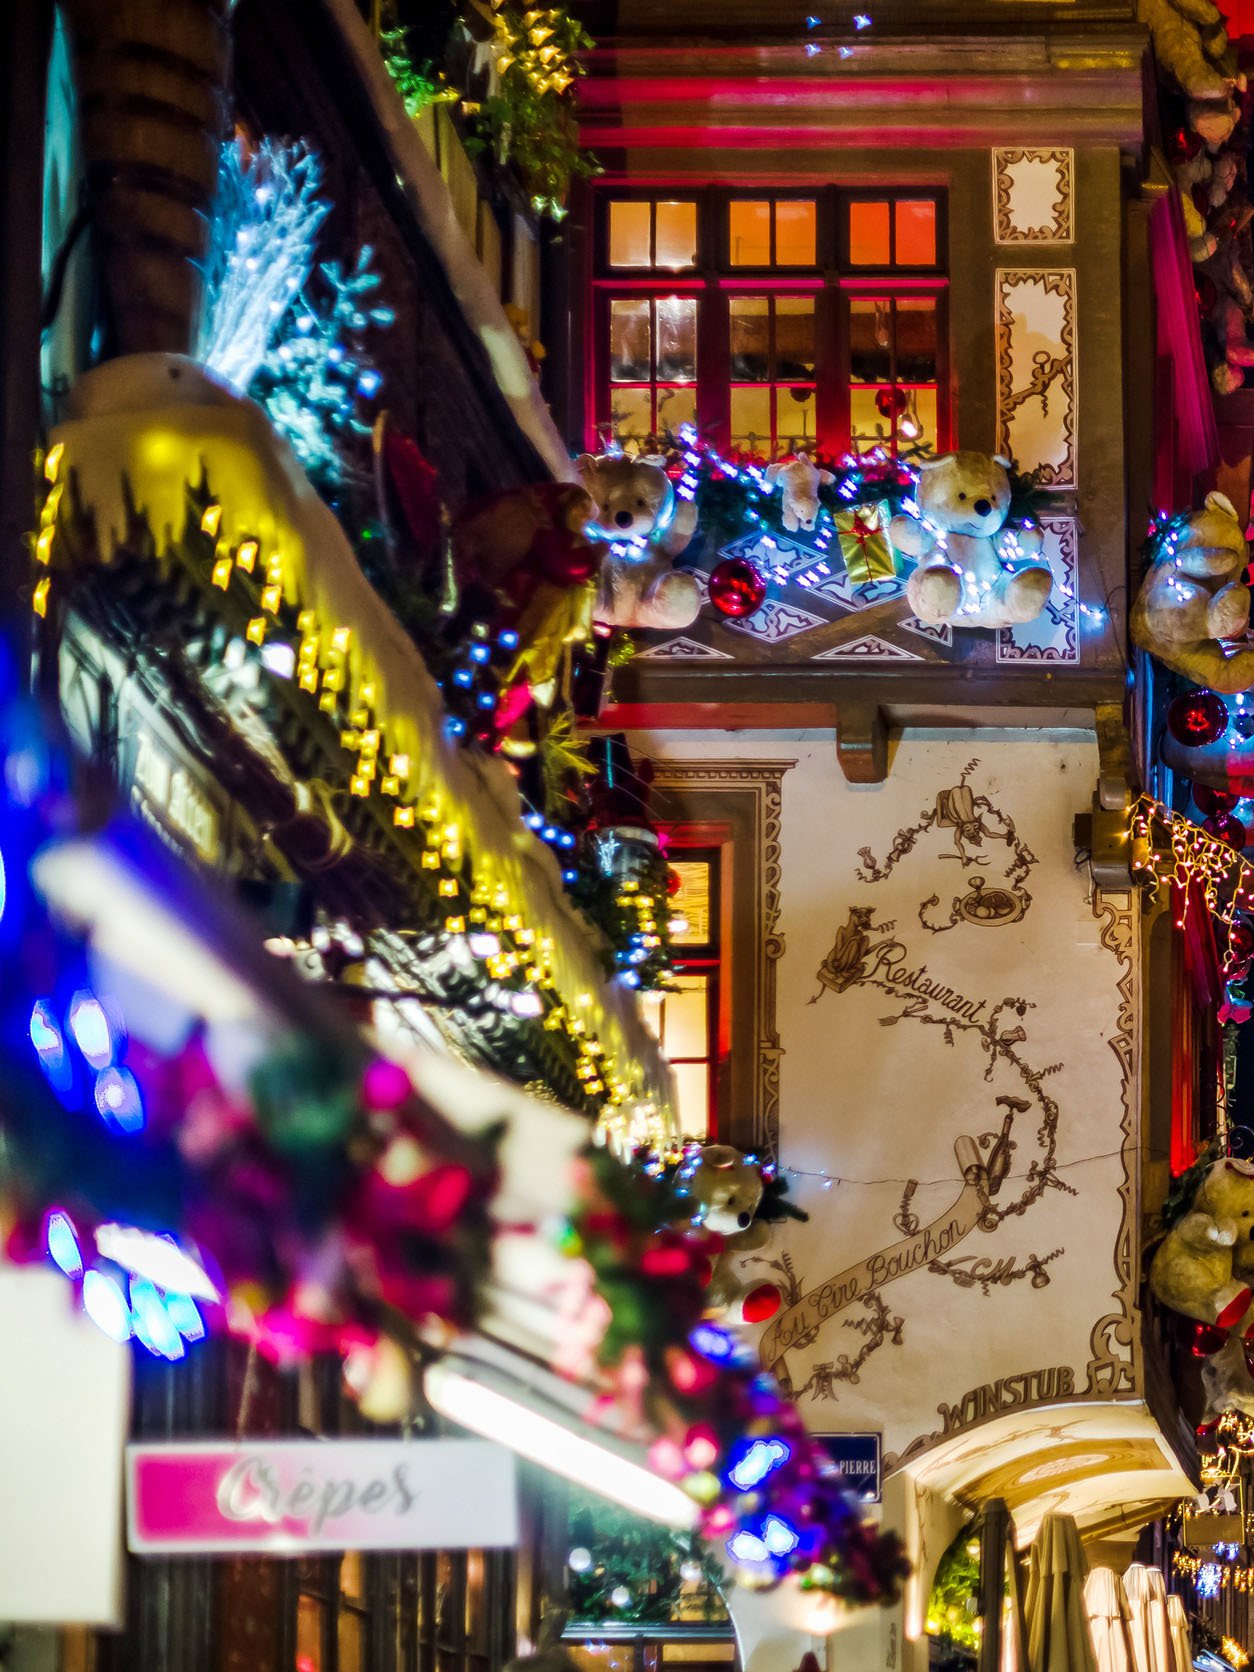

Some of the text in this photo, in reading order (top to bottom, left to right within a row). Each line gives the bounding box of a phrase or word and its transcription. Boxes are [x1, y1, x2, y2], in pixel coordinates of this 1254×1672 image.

[862, 942, 986, 1023] Restaurant
[808, 1276, 862, 1318] Tire
[866, 1218, 966, 1291] Bouchon
[936, 1366, 1076, 1435] WINSTUB
[216, 1455, 421, 1538] Crêpes
[839, 1460, 877, 1475] PIERRE
